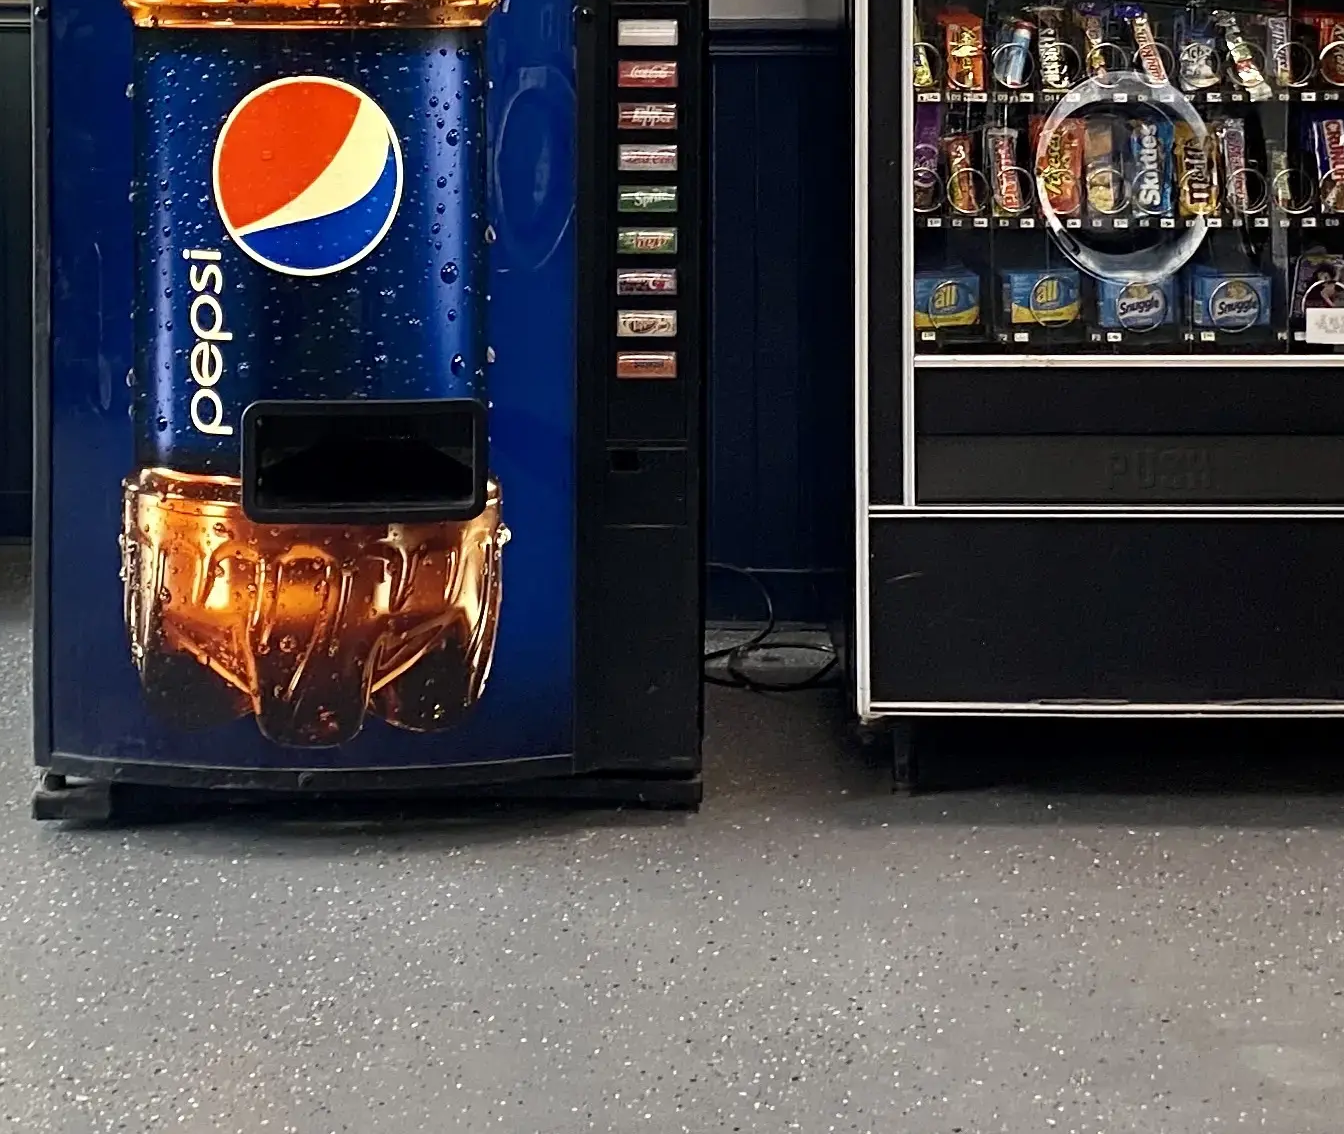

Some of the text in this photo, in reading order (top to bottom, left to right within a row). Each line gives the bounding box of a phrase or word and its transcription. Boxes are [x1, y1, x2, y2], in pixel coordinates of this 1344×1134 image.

[934, 285, 957, 309] all
[1035, 280, 1058, 304] all
[1120, 299, 1160, 316] Snuggle
[1218, 299, 1258, 316] Snuggle
[183, 248, 233, 436] pepsi
